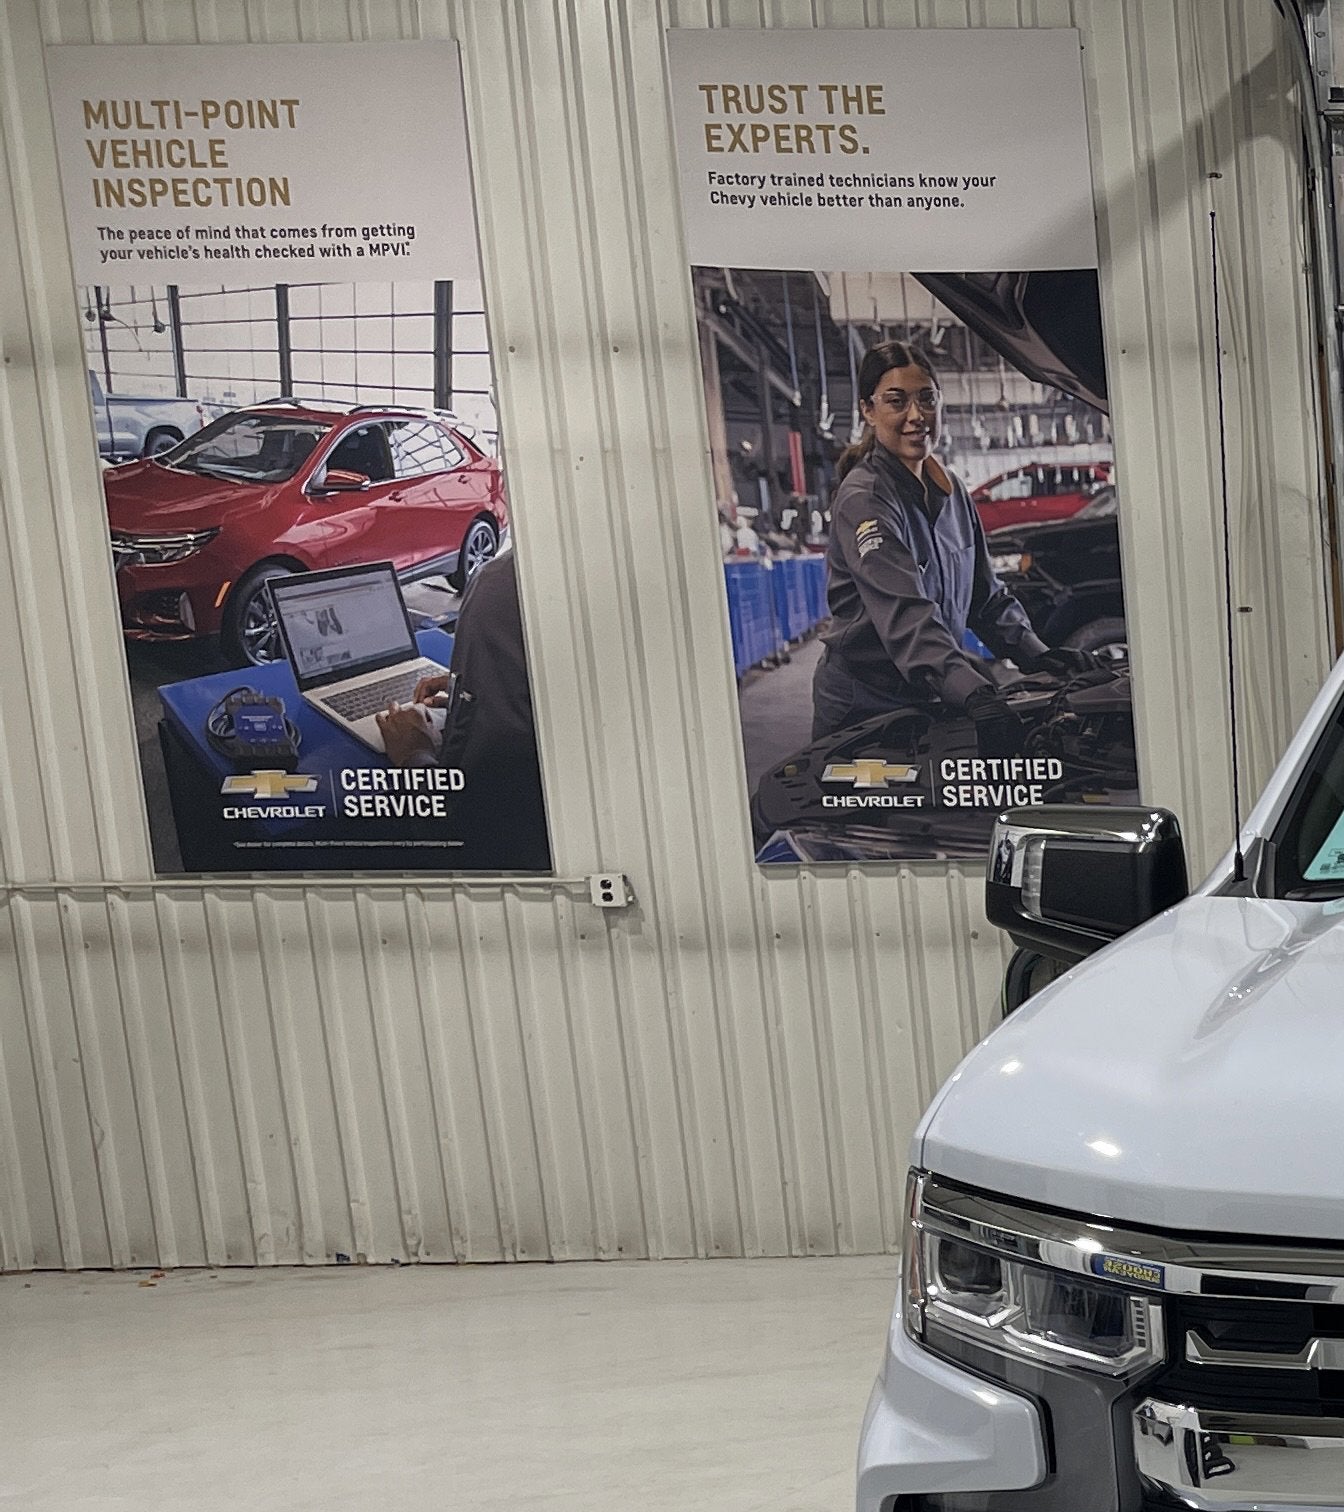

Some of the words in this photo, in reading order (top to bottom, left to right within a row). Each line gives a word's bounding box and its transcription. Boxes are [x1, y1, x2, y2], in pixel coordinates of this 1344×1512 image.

[699, 84, 808, 115] TRUST
[819, 85, 886, 115] THE
[83, 99, 300, 130] MULTI-POINT
[704, 124, 870, 155] EXPERTS.
[86, 139, 229, 169] VEHICLE
[708, 171, 766, 189] Factory
[770, 173, 824, 187] trained
[829, 173, 915, 188] technicians
[919, 173, 958, 188] know
[962, 176, 996, 190] your
[93, 177, 292, 208] INSPECTION
[710, 191, 756, 208] Chevy
[760, 192, 813, 206] vehicle
[817, 193, 864, 207] better
[868, 193, 902, 208] than
[907, 196, 965, 210] anyone.
[97, 226, 124, 240] The
[129, 229, 172, 244] peace
[176, 225, 191, 240] of
[195, 226, 231, 239] mind
[235, 225, 265, 239] that
[270, 227, 317, 239] comes
[321, 224, 357, 238] from
[362, 223, 415, 240] getting
[100, 249, 133, 264] your
[137, 245, 200, 260] vehicle's
[204, 244, 250, 259] health
[255, 244, 315, 259] checked
[319, 243, 351, 257] with
[356, 246, 365, 257] a
[340, 768, 465, 791] CERTIFIED
[940, 758, 1063, 781] CERTIFIED
[344, 795, 447, 817] SERVICE
[822, 795, 925, 808] CHEVROLET
[942, 784, 1044, 806] SERVICE
[223, 805, 326, 819] CHEVROLET
